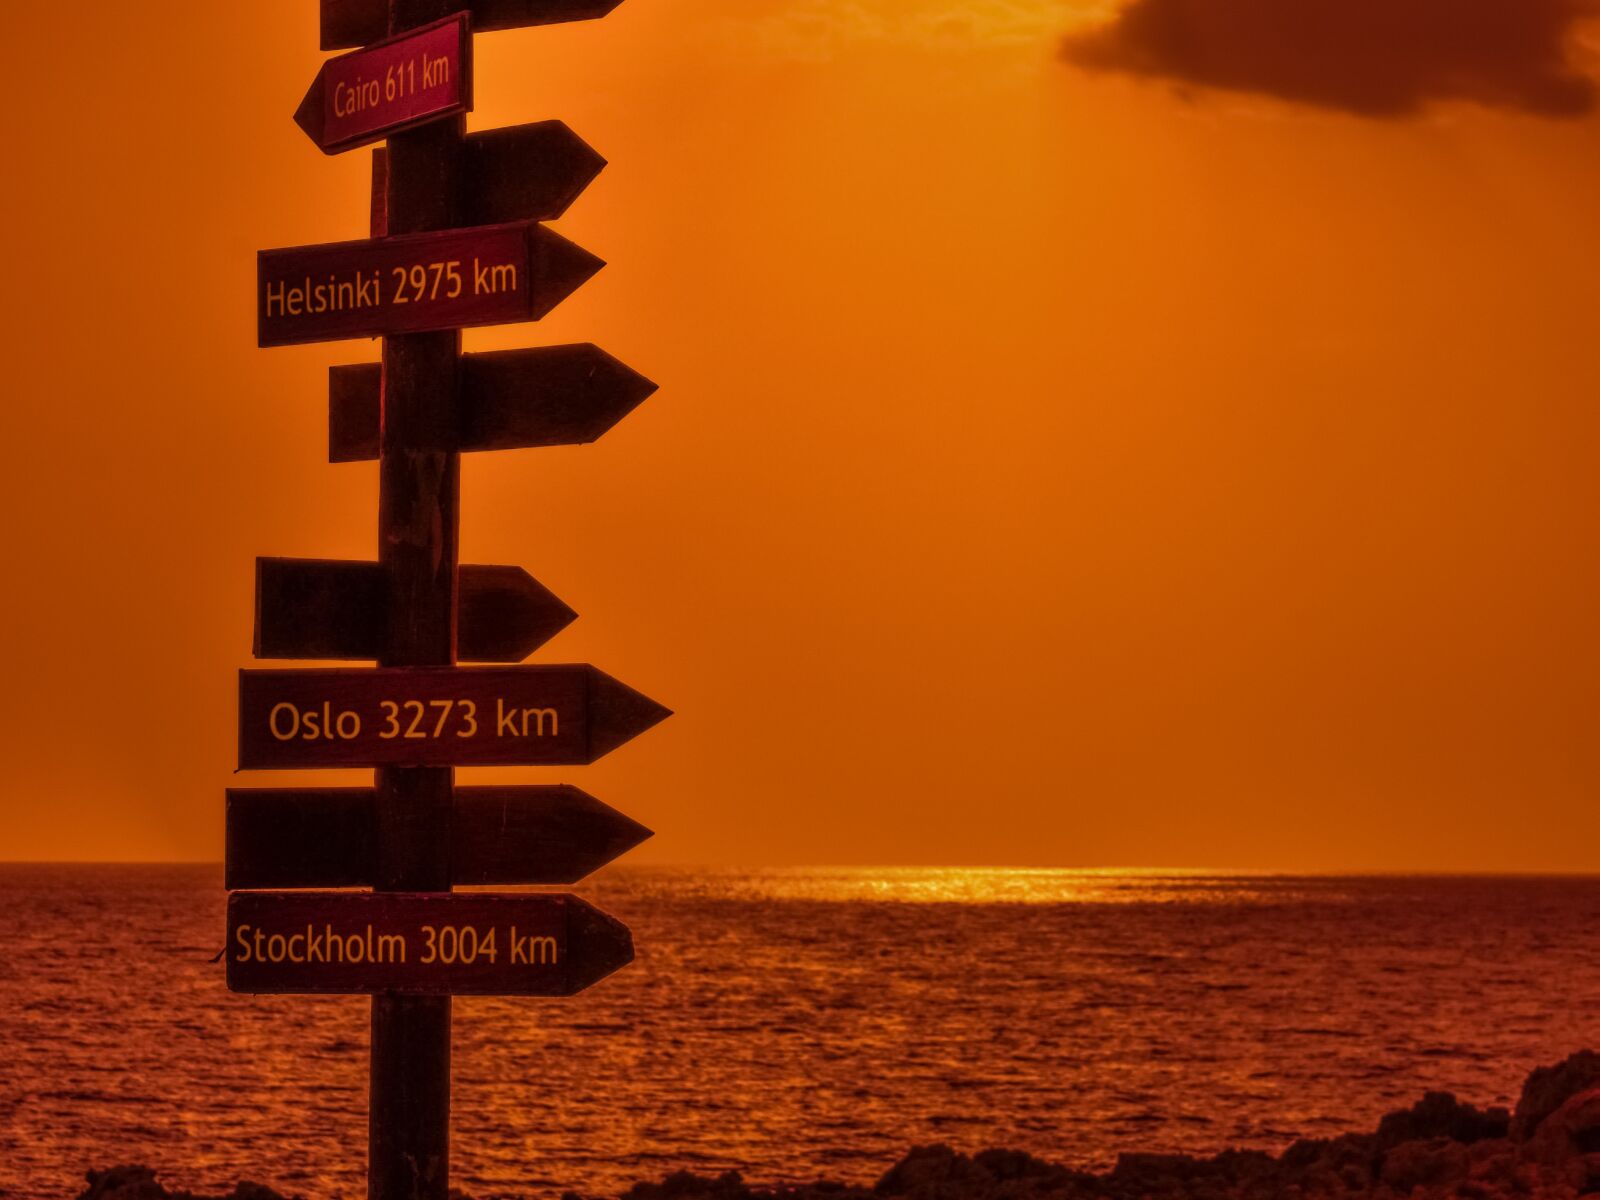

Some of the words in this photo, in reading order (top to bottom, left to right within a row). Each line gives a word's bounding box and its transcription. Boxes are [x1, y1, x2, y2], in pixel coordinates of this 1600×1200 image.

[334, 77, 380, 118] Cairo
[385, 59, 415, 102] 611
[423, 53, 449, 90] km
[266, 270, 380, 317] Helsinki
[392, 260, 462, 304] 2975
[474, 257, 517, 295] km
[269, 701, 361, 741] Oslo
[378, 699, 478, 739] 3273
[497, 698, 558, 737] km
[236, 923, 406, 963] Stockholm
[420, 925, 498, 964] 3004
[510, 925, 557, 964] km
